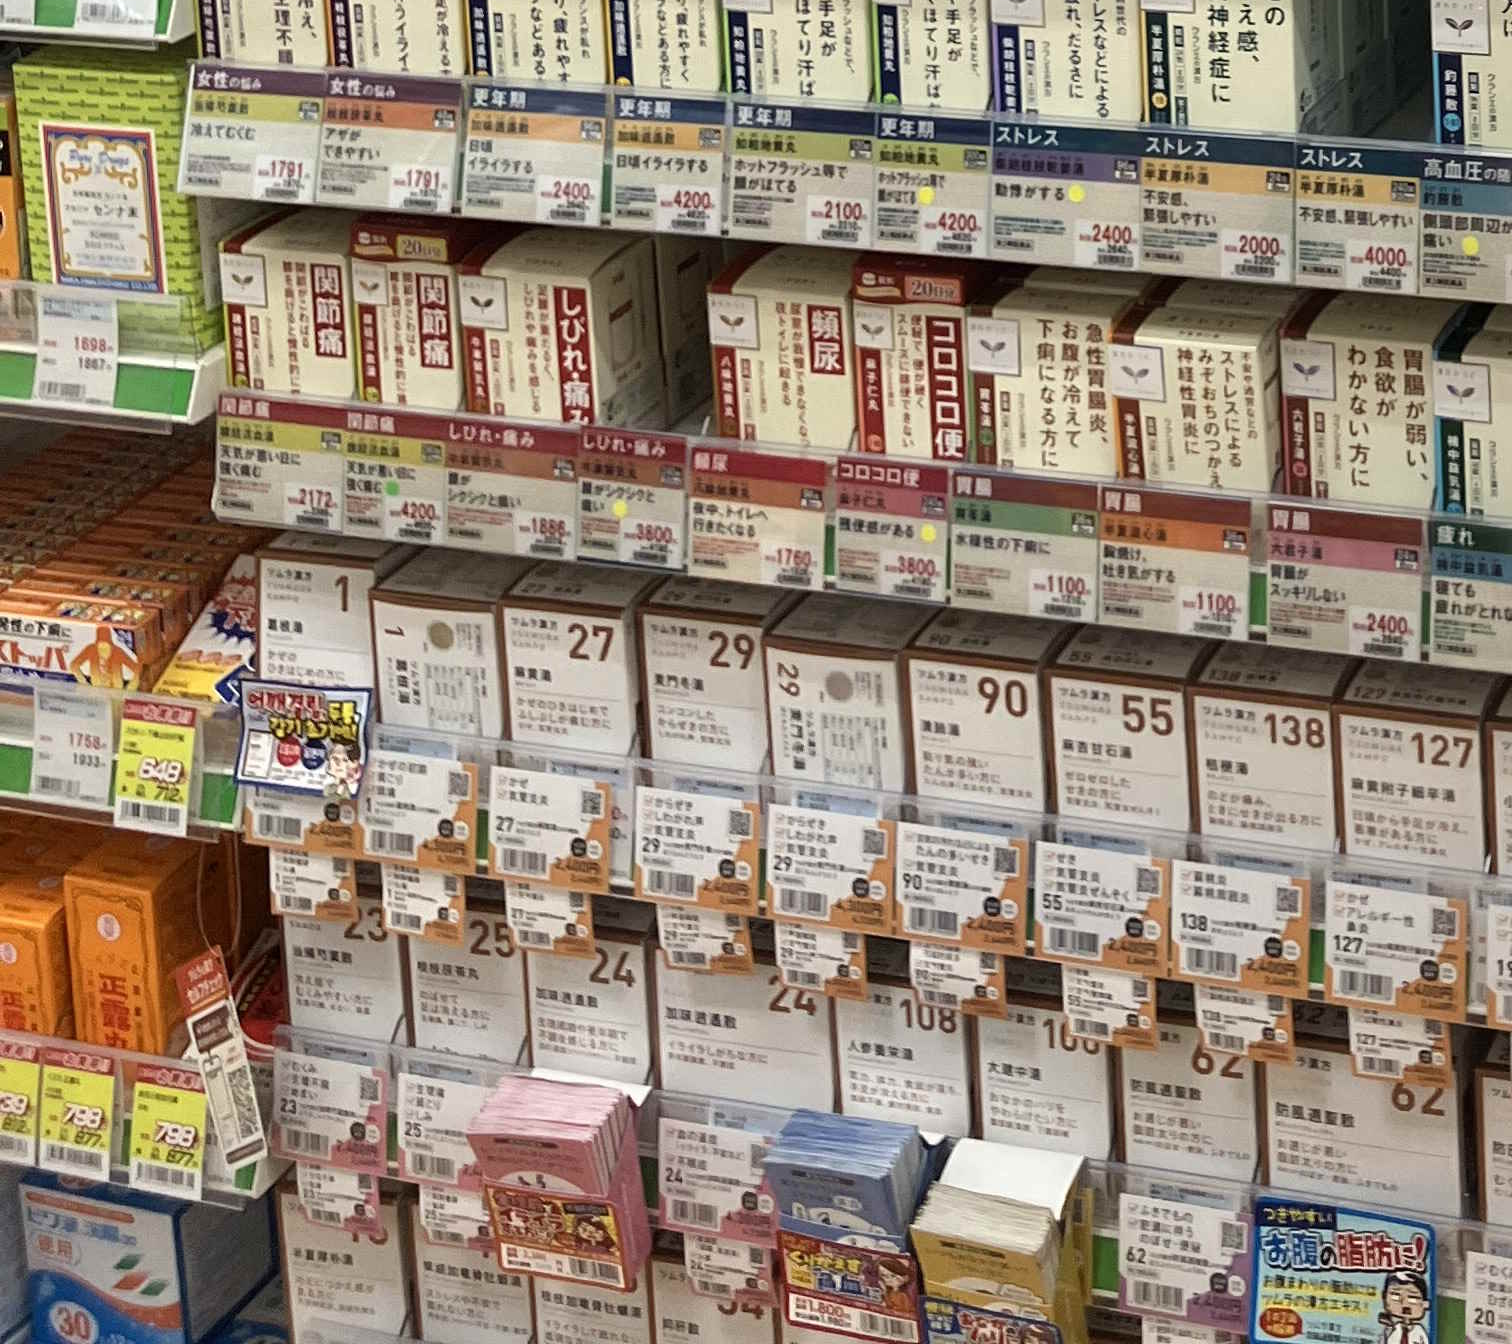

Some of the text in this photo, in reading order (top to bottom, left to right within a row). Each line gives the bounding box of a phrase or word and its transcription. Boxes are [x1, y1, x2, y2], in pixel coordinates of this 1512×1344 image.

[996, 125, 1059, 146] ストレス
[314, 265, 344, 357] 関節痛
[810, 308, 846, 371] 頻尿
[933, 319, 964, 458] コロコロ便
[1347, 345, 1370, 488] わかない方に
[335, 576, 350, 611] 1
[568, 624, 614, 662] 27
[709, 630, 754, 669] 29
[978, 676, 1028, 717] 90
[1122, 695, 1174, 736] 55
[1264, 713, 1326, 748] 138
[1411, 732, 1473, 769] 127
